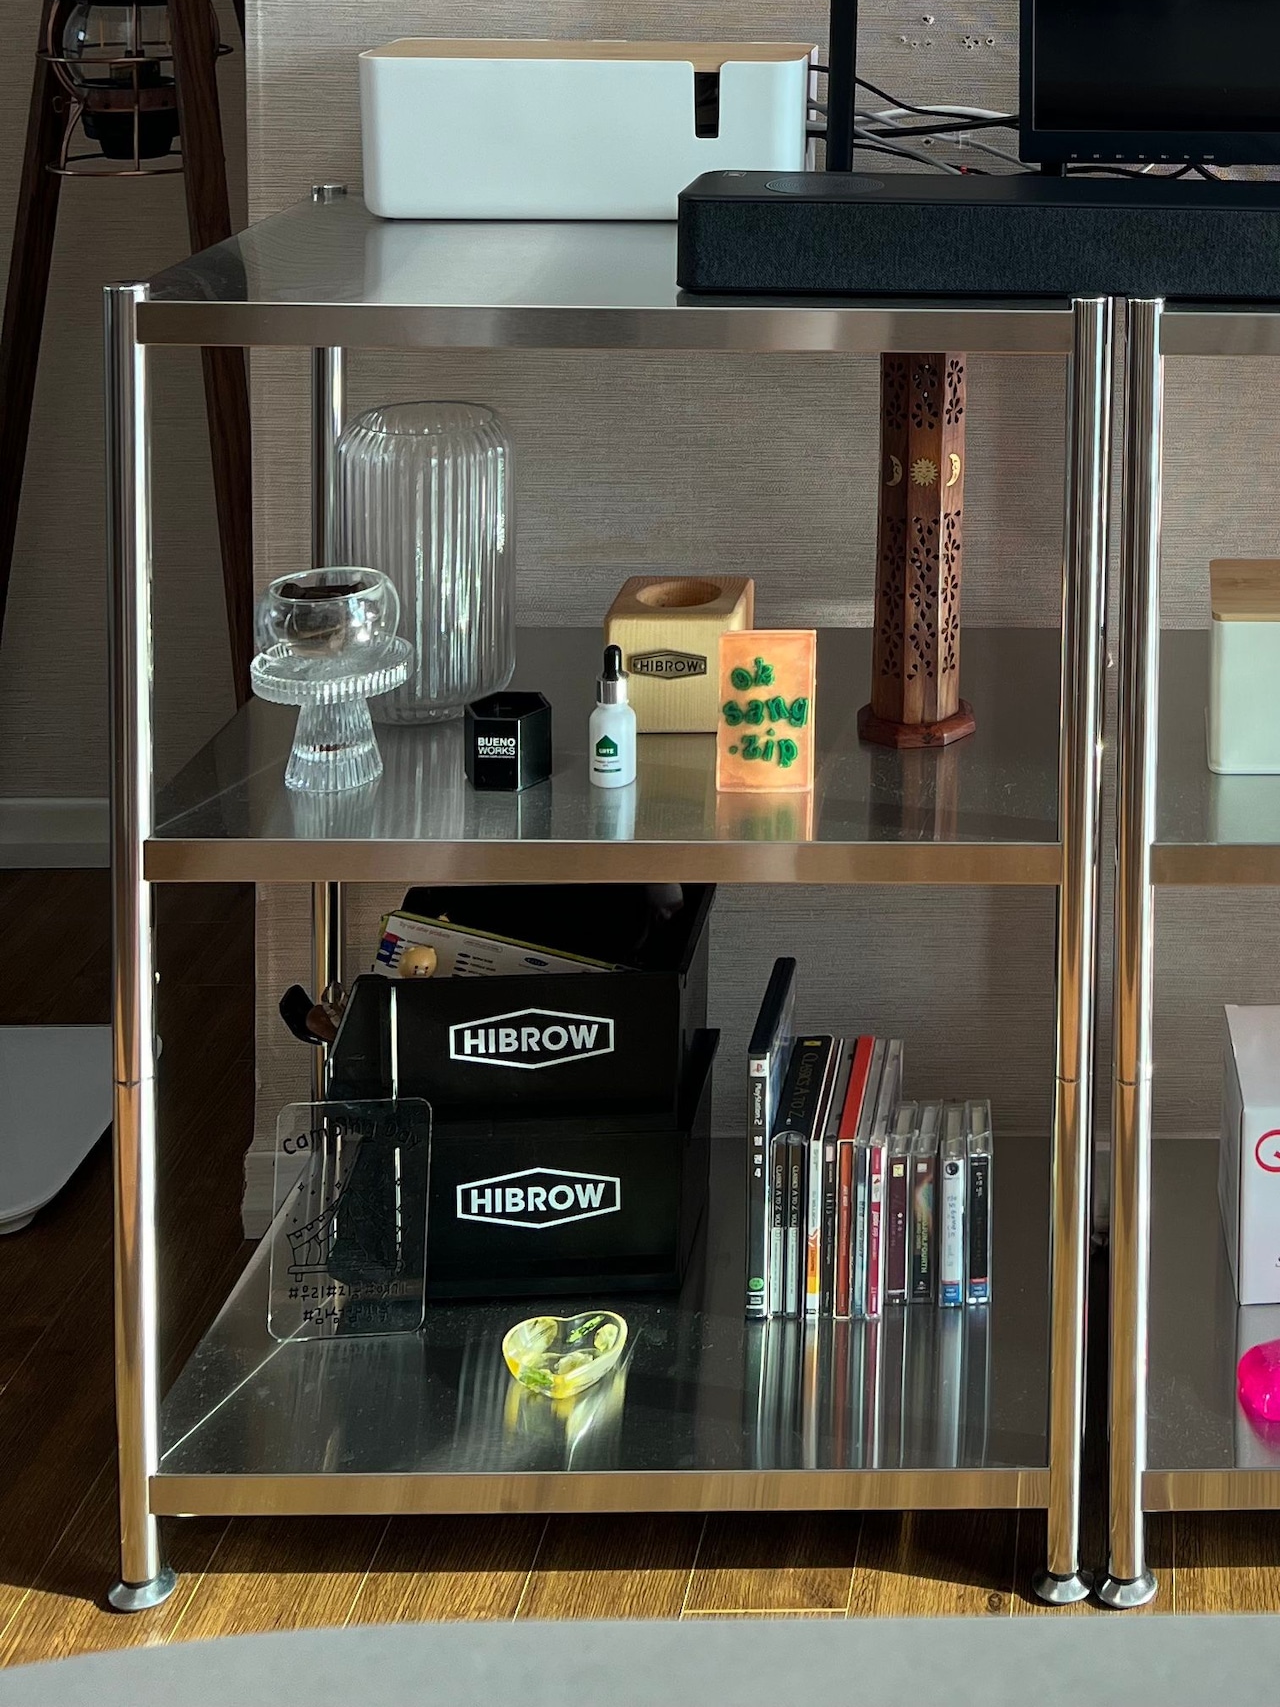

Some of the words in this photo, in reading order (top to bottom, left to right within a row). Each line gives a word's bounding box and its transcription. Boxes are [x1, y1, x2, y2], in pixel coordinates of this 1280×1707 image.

[640, 660, 700, 673] HIBROW
[730, 656, 776, 692] ok
[722, 695, 810, 729] sang
[477, 736, 516, 747] BUENO
[477, 746, 516, 756] WORKS
[463, 1023, 600, 1055] HIBROW
[470, 1182, 606, 1214] HIBROW
